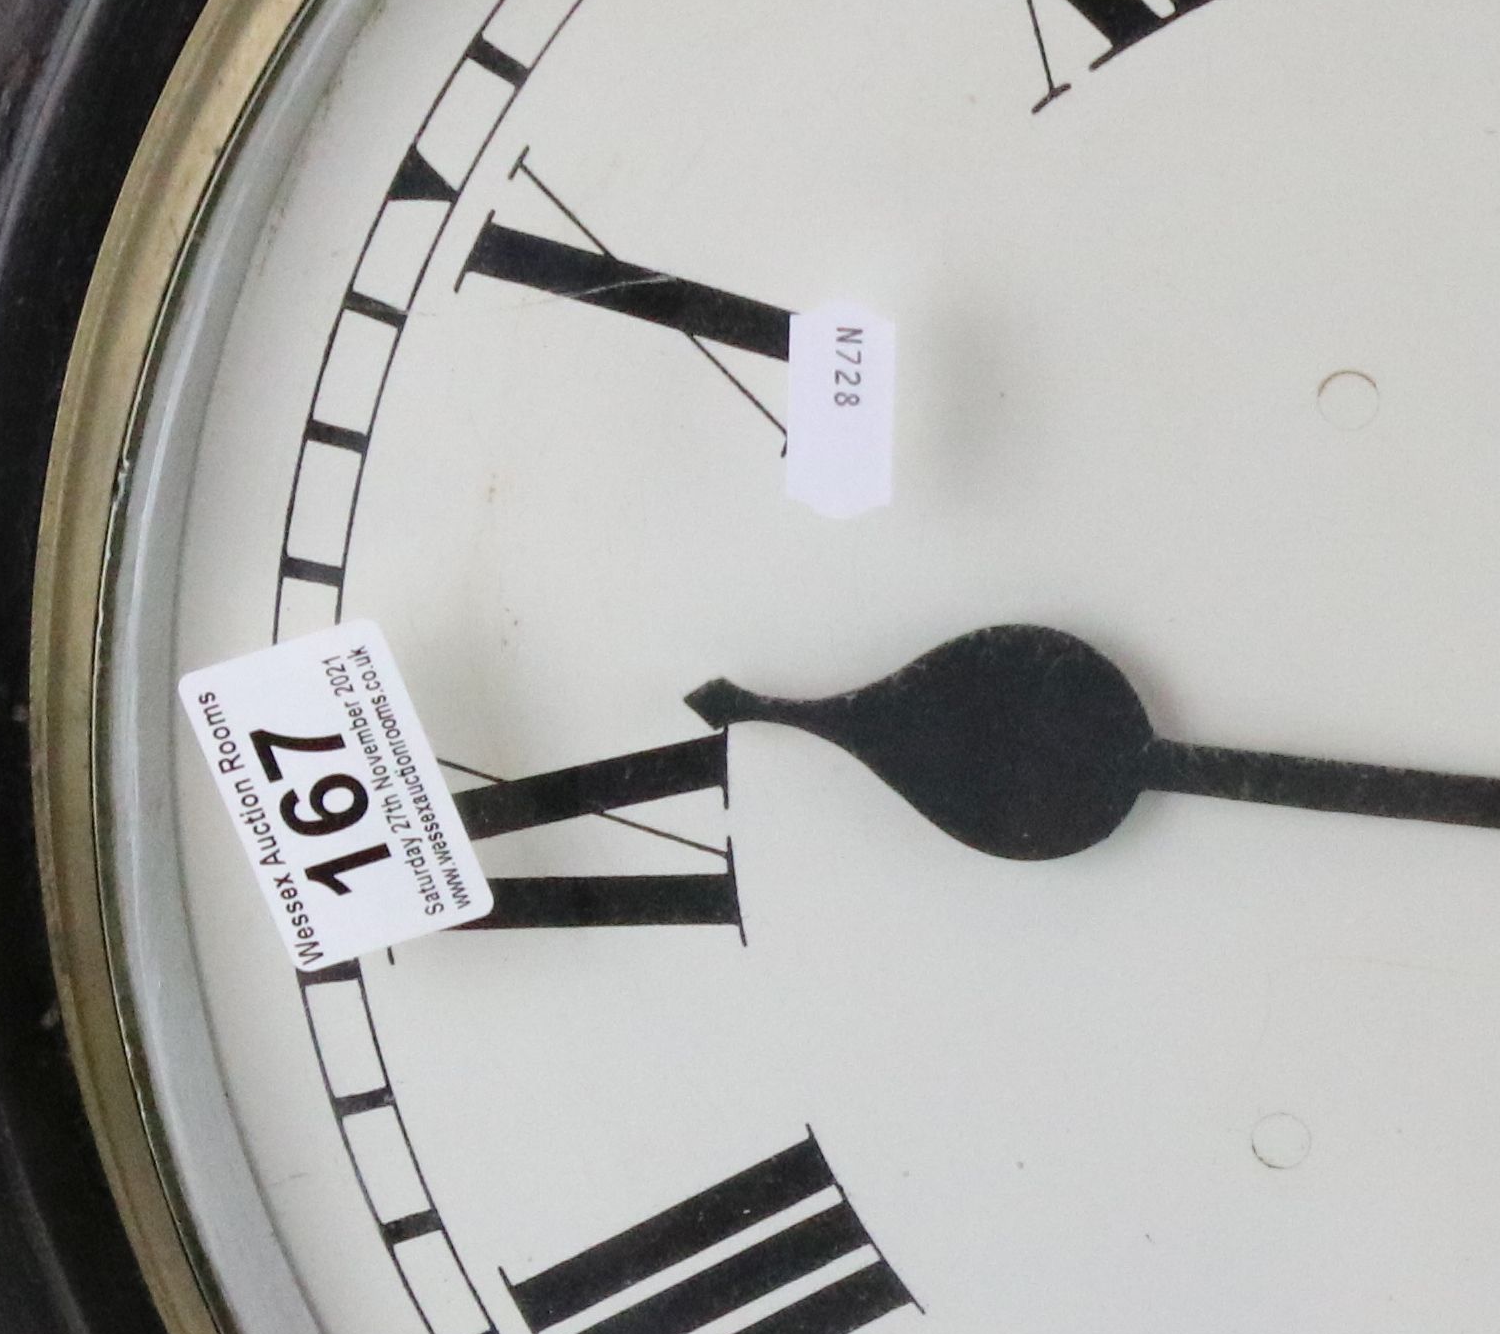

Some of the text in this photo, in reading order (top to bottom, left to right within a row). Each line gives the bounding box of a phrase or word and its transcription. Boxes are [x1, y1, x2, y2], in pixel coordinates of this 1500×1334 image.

[454, 145, 799, 458] X
[833, 325, 863, 408] N728
[198, 691, 324, 965] Wessex Auction Rooms
[249, 728, 392, 896] 167
[321, 655, 444, 915] Saturday 27th November 2021
[347, 645, 471, 910] www.wessexauctionrooms.co.uk
